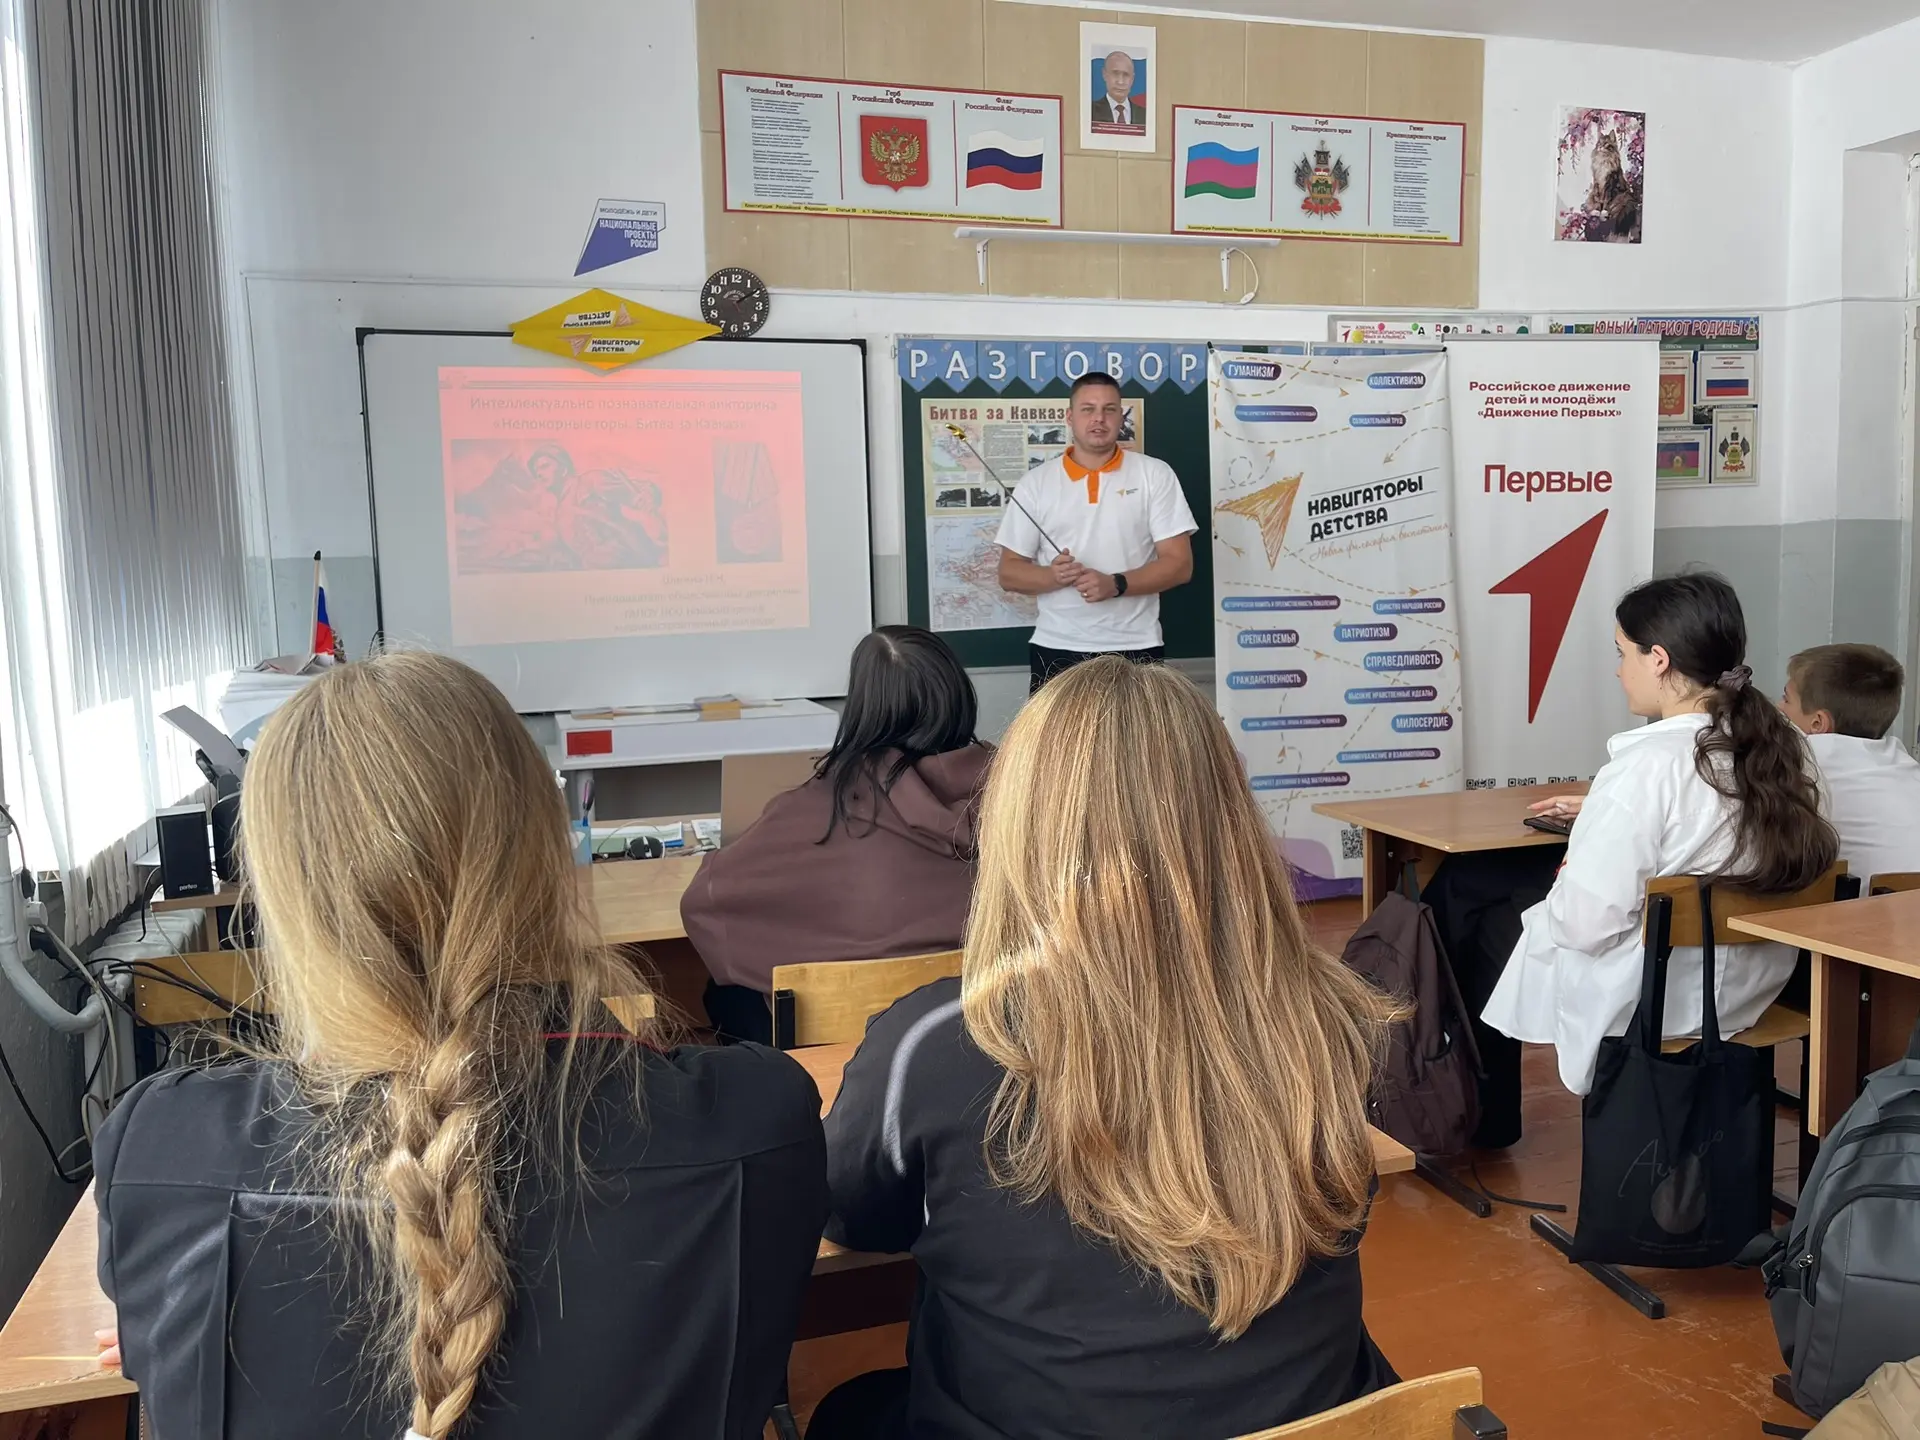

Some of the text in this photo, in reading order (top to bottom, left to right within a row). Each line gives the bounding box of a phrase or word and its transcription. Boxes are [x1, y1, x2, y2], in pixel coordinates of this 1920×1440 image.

[746, 86, 823, 99] Российской Федерации
[885, 90, 901, 98] Герб
[852, 94, 934, 107] Российской Федерации
[964, 102, 1044, 114] Российской Федерации
[1314, 119, 1329, 127] Герб
[600, 219, 657, 231] НАЦИОНАЛЬНЫЕ
[624, 230, 657, 240] ПРОЕКТЫ
[630, 239, 657, 249] РОССИИ
[720, 276, 728, 286] 11
[732, 274, 742, 283] 12
[746, 279, 751, 288] 1
[710, 285, 722, 294] 10
[752, 288, 760, 298] 2
[707, 296, 715, 306] 9
[755, 302, 763, 310] 3
[578, 311, 611, 320] ДЕТСТВА
[710, 309, 718, 318] 8
[751, 313, 758, 322] 4
[719, 320, 726, 328] 7
[730, 324, 738, 333] 6
[743, 322, 750, 330] 5
[1593, 318, 1744, 340] ЮНЫЙ ПАТРИОТ РОДИНЫ
[910, 349, 1198, 382] РАЗГОВОР
[1228, 364, 1276, 378] ГУМАНИЗМ
[1369, 374, 1424, 386] КОЛЛЕКТИВИЗМ
[1469, 381, 1631, 393] Российское движение
[1484, 394, 1616, 405] детей и молодёжи
[930, 406, 1065, 421] Битва за Кавказ
[1478, 408, 1622, 419] «Движение Первых»
[1484, 464, 1613, 502] Первые
[1308, 476, 1423, 516] НАВИГАТОРЫ
[1310, 507, 1388, 542] ДЕТСТВА
[1240, 632, 1297, 644] КРЕПКАЯ СЕМЬЯ
[1341, 627, 1390, 638] ПАТРИОТИЗМ
[1366, 653, 1440, 667] СПРАВЕДЛИВОСТЬ
[1232, 674, 1301, 685] ГРАЖДАНСТВЕННОСТЬ
[1396, 716, 1449, 728] МИЛОСЕРДИЕ
